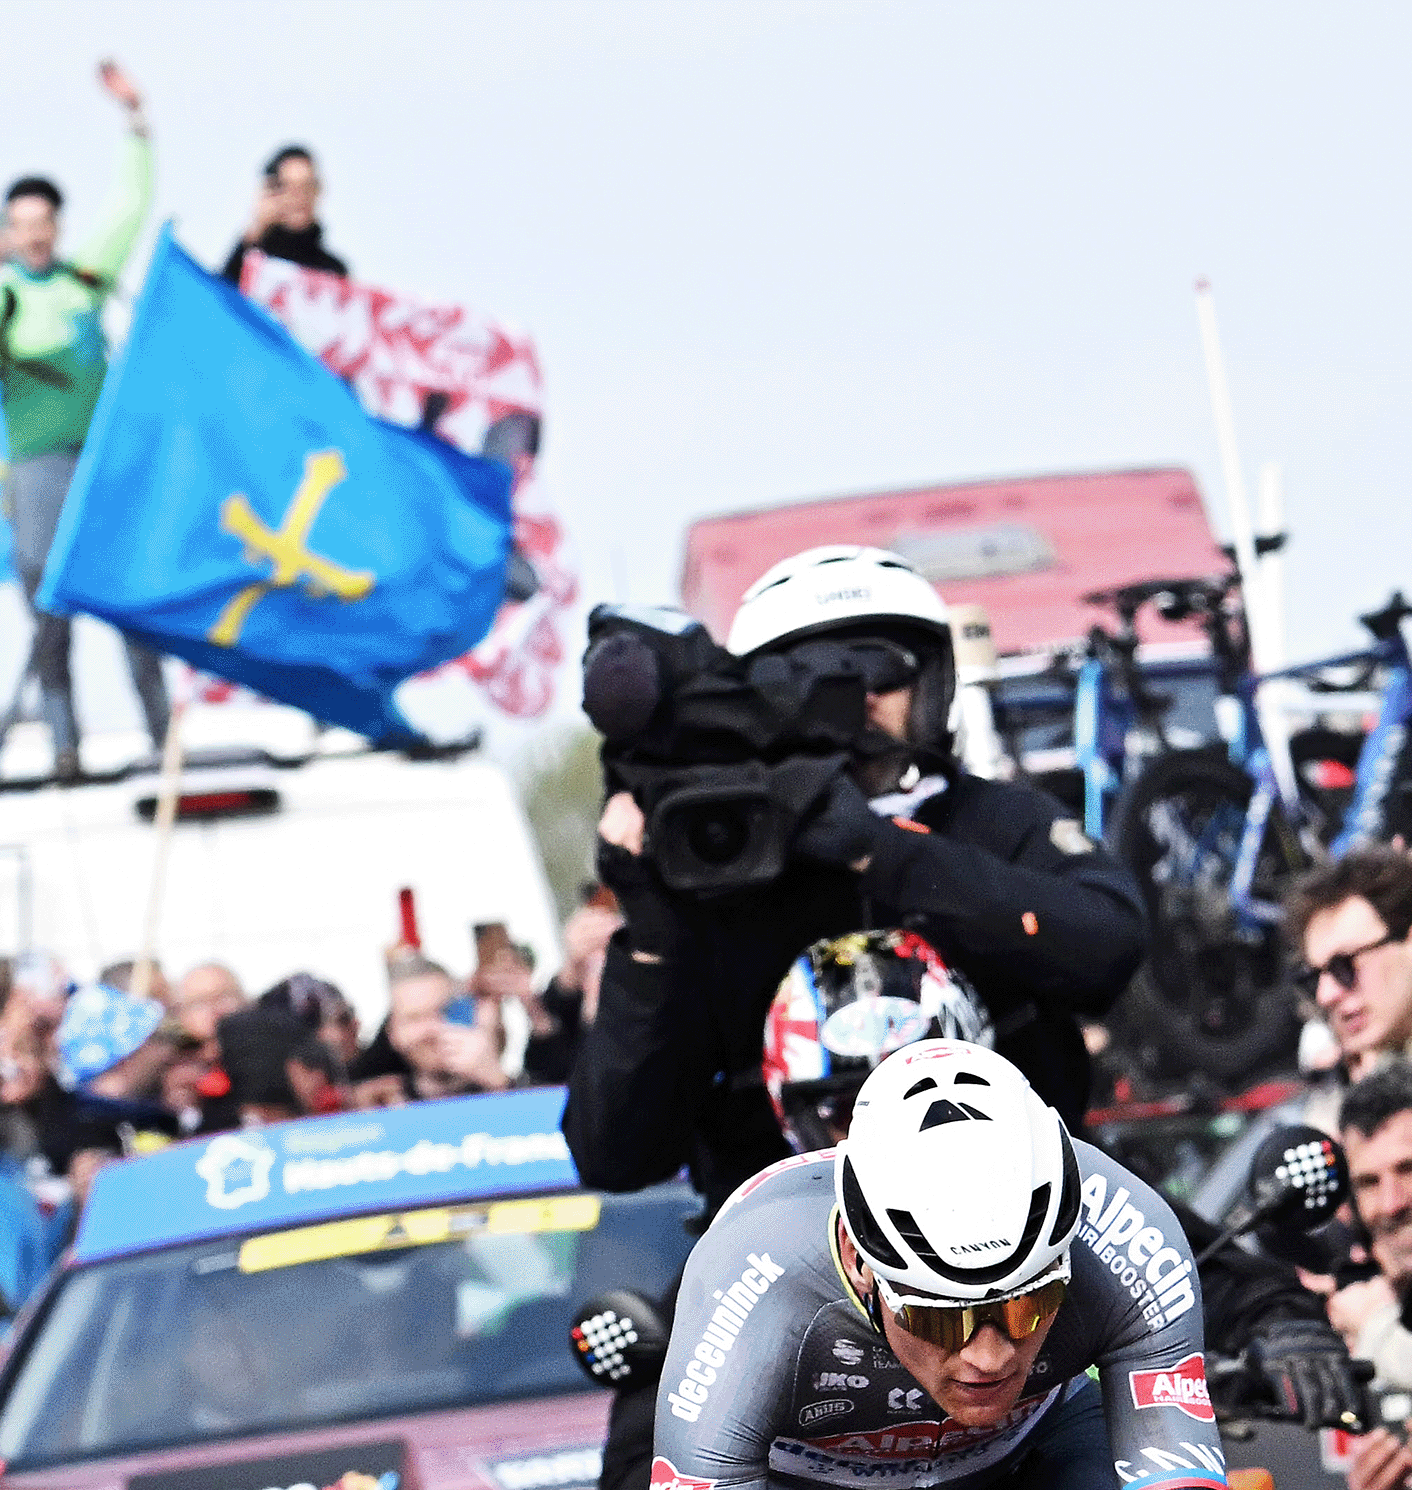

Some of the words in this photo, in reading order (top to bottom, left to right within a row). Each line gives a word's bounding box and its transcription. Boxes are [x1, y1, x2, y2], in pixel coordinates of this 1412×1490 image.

[949, 1238, 1012, 1255] CANYON
[1081, 1173, 1196, 1323] Alpecin
[667, 1252, 786, 1423] deceuninck
